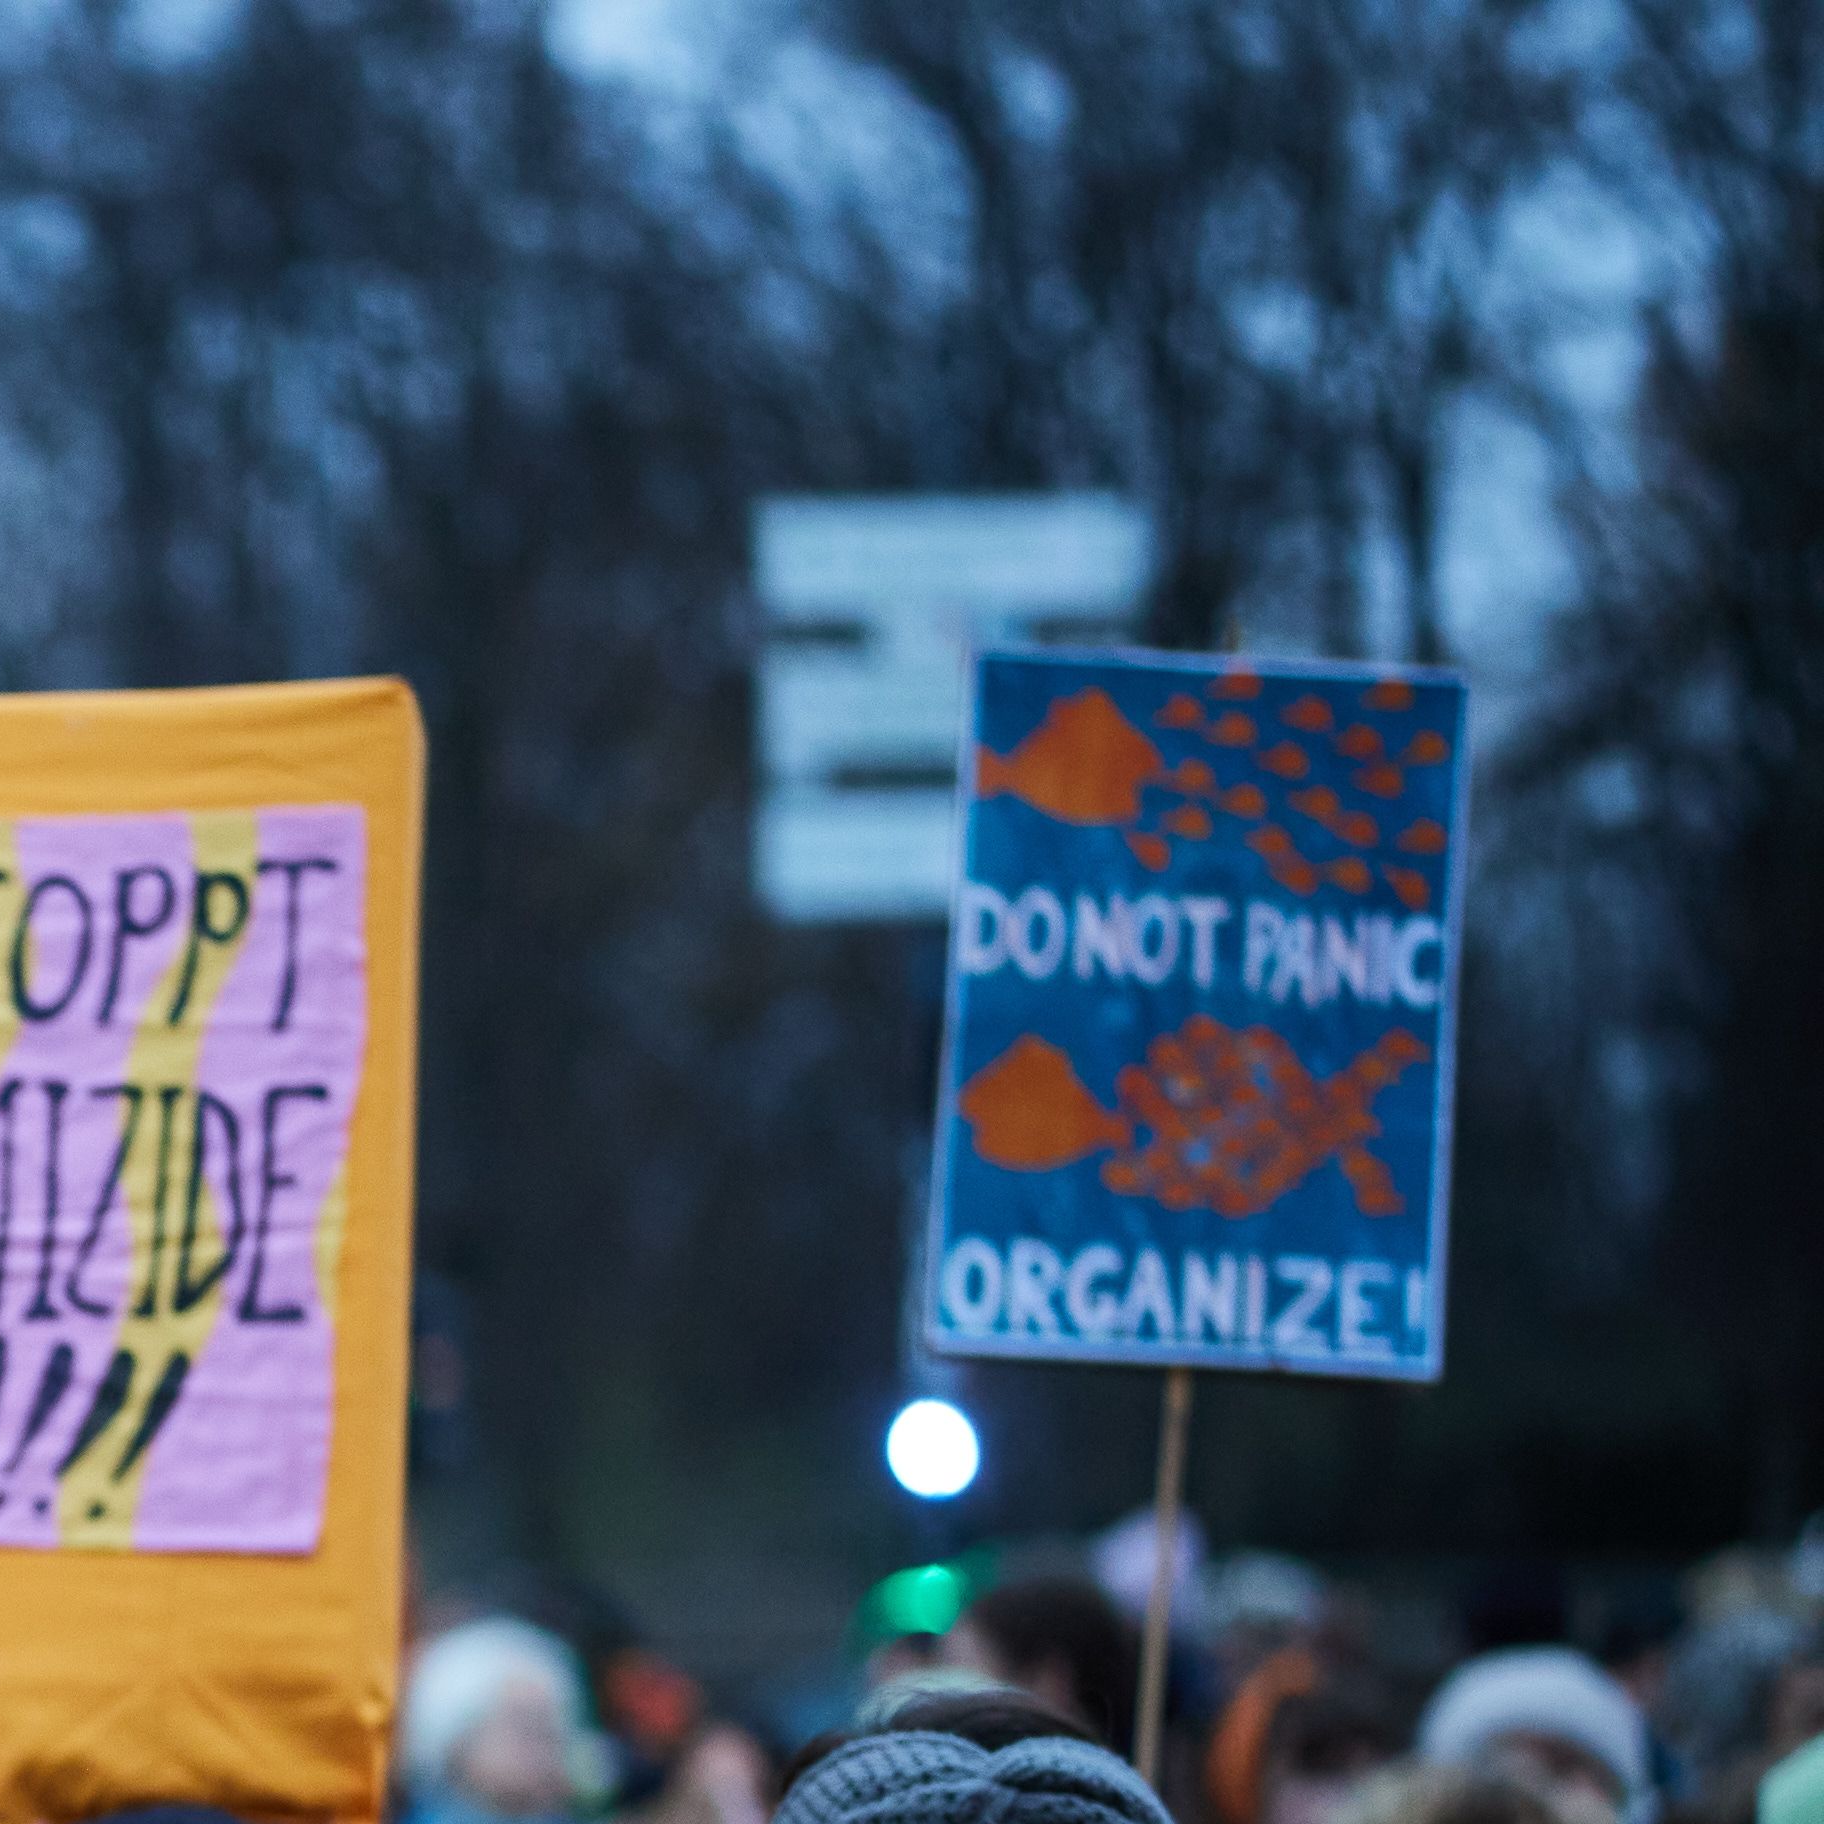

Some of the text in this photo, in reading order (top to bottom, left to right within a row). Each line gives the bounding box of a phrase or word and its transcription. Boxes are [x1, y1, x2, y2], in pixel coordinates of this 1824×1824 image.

[1072, 891, 1230, 990] NOT
[1242, 901, 1441, 1012] PANIC
[940, 1234, 1432, 1358] ORGANIZE!
